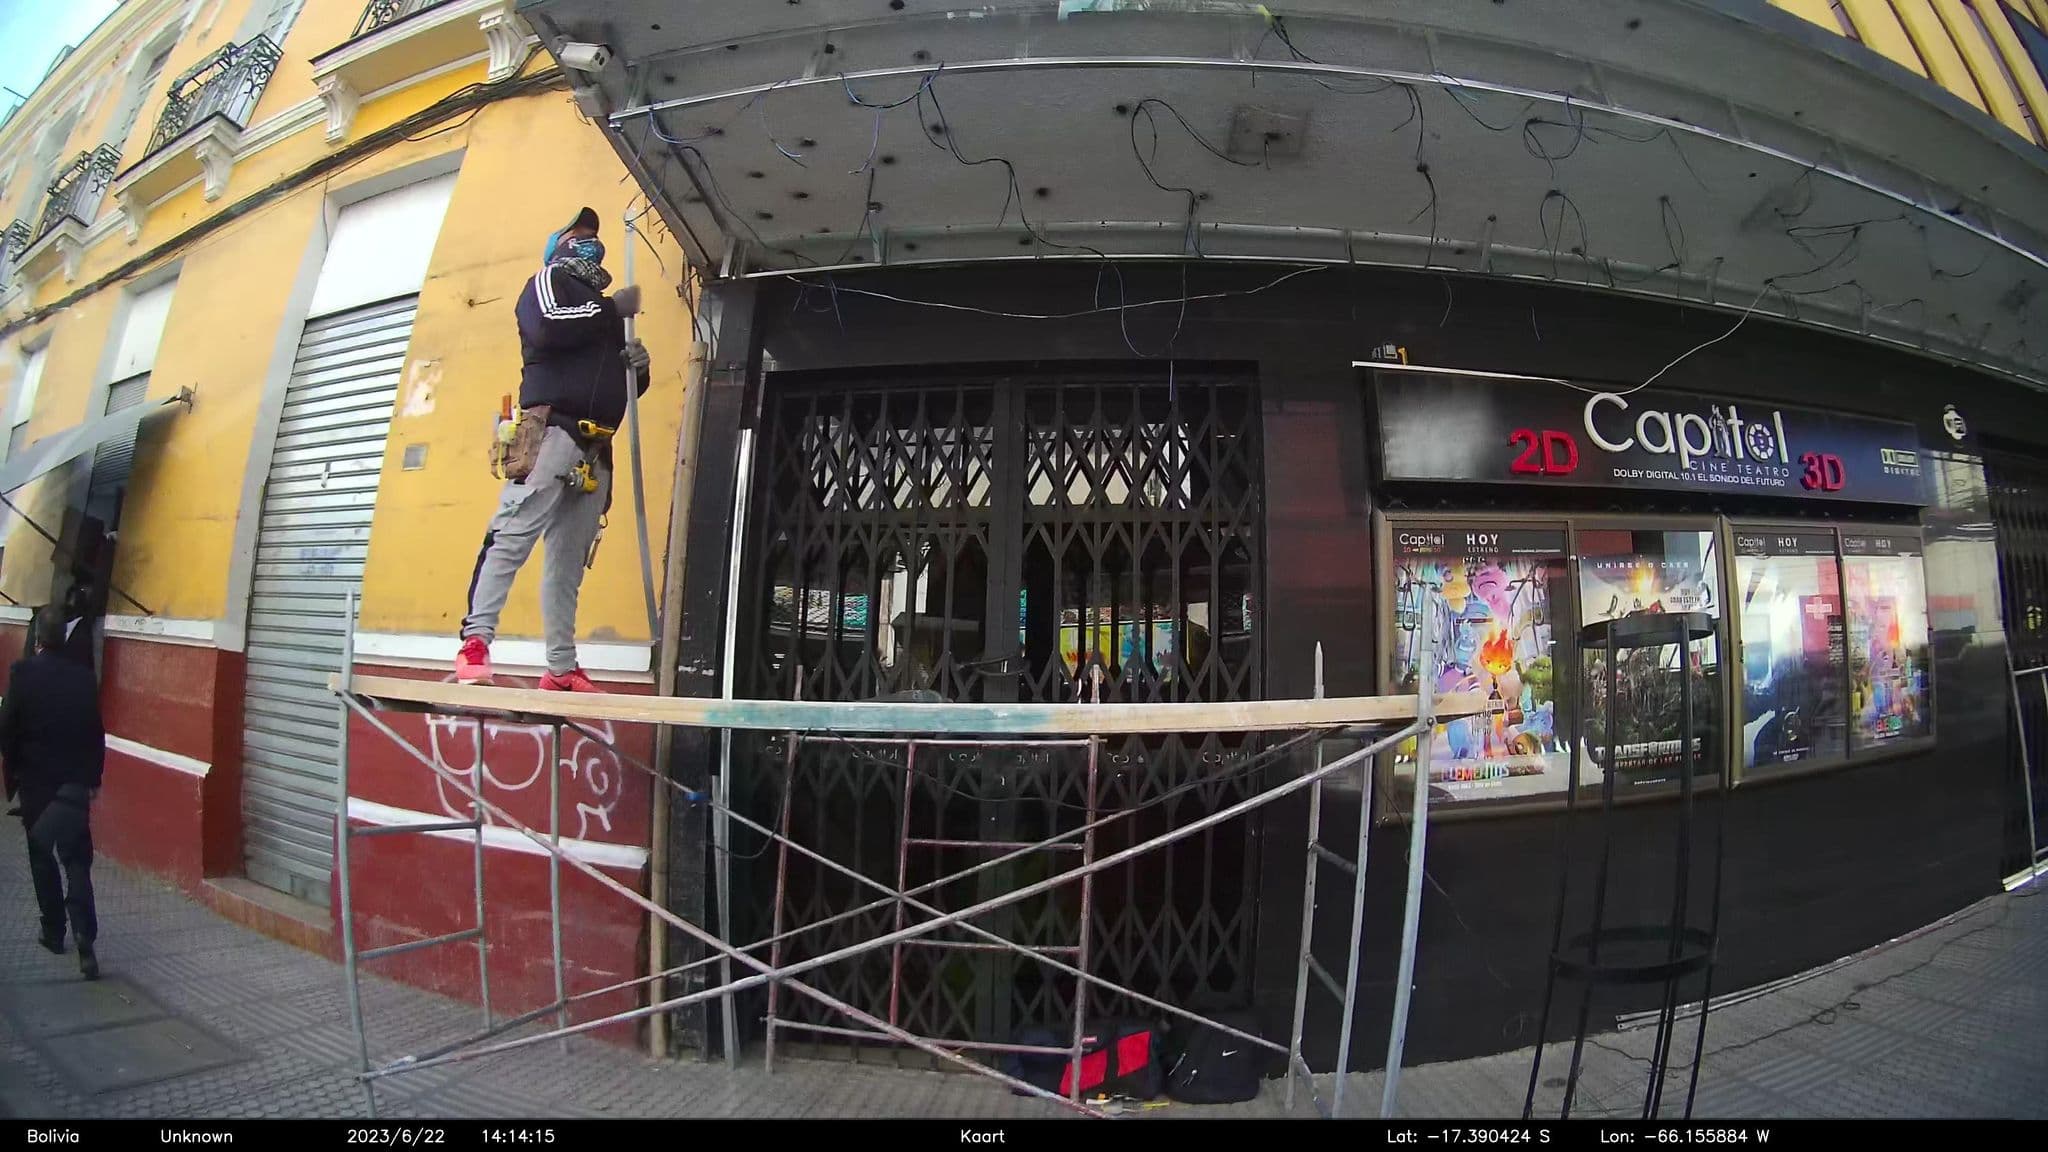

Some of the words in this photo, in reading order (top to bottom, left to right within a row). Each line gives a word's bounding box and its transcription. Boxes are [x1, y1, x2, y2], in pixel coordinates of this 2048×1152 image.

[1584, 393, 1789, 470] Capitol
[1509, 428, 1579, 475] 2D
[1613, 468, 1644, 478] DOLBY
[1646, 471, 1679, 480] DIGITAL
[1681, 473, 1696, 481] 10.1
[1698, 473, 1708, 482] EL
[1709, 474, 1739, 484] SONIDO
[1740, 477, 1754, 485] DEL
[1756, 477, 1785, 487] FUTURO
[1689, 460, 1727, 473] CINE
[1737, 464, 1790, 478] TEATRO
[1800, 452, 1847, 491] 3D
[1399, 533, 1445, 547] Capitol
[1466, 533, 1499, 545] HOY
[1778, 537, 1798, 548] HOY
